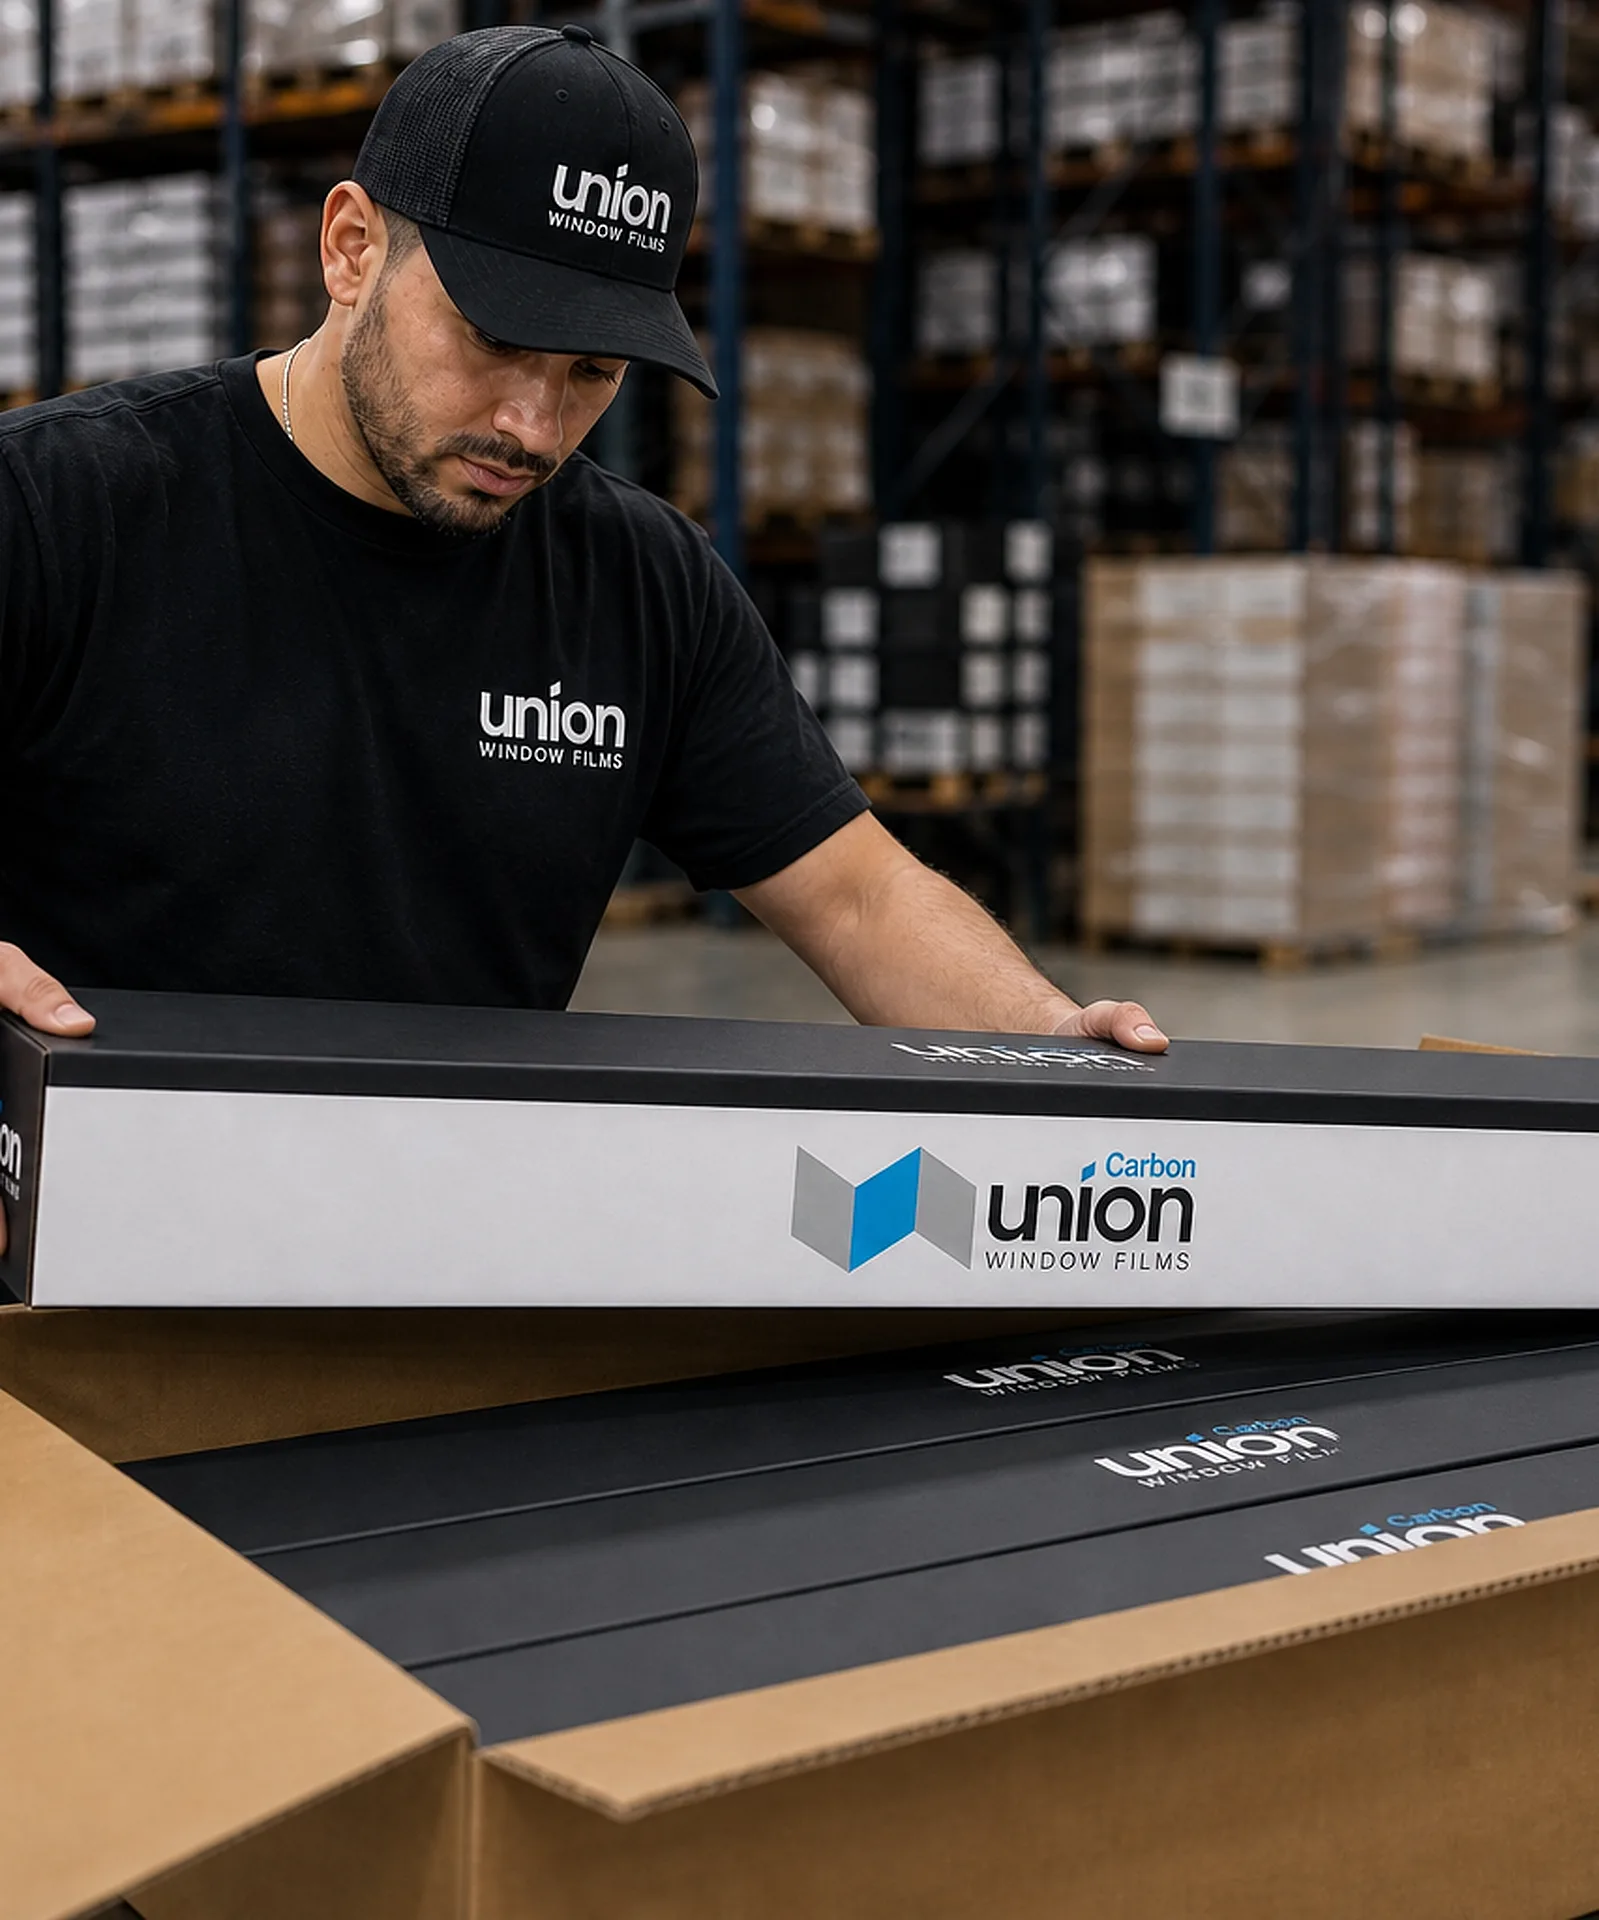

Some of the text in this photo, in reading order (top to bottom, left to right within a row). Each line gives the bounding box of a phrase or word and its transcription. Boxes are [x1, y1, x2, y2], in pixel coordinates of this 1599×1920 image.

[552, 163, 671, 234] union
[548, 209, 623, 242] WINDOW
[480, 680, 626, 748] union
[479, 740, 624, 770] WINDOW FILMS
[1105, 1151, 1197, 1179] Carbon
[987, 1161, 1195, 1243] union
[984, 1251, 1190, 1271] WINDOW FILMS
[943, 1349, 1185, 1388] union
[1094, 1425, 1341, 1477] union
[1386, 1501, 1497, 1528] Carbon
